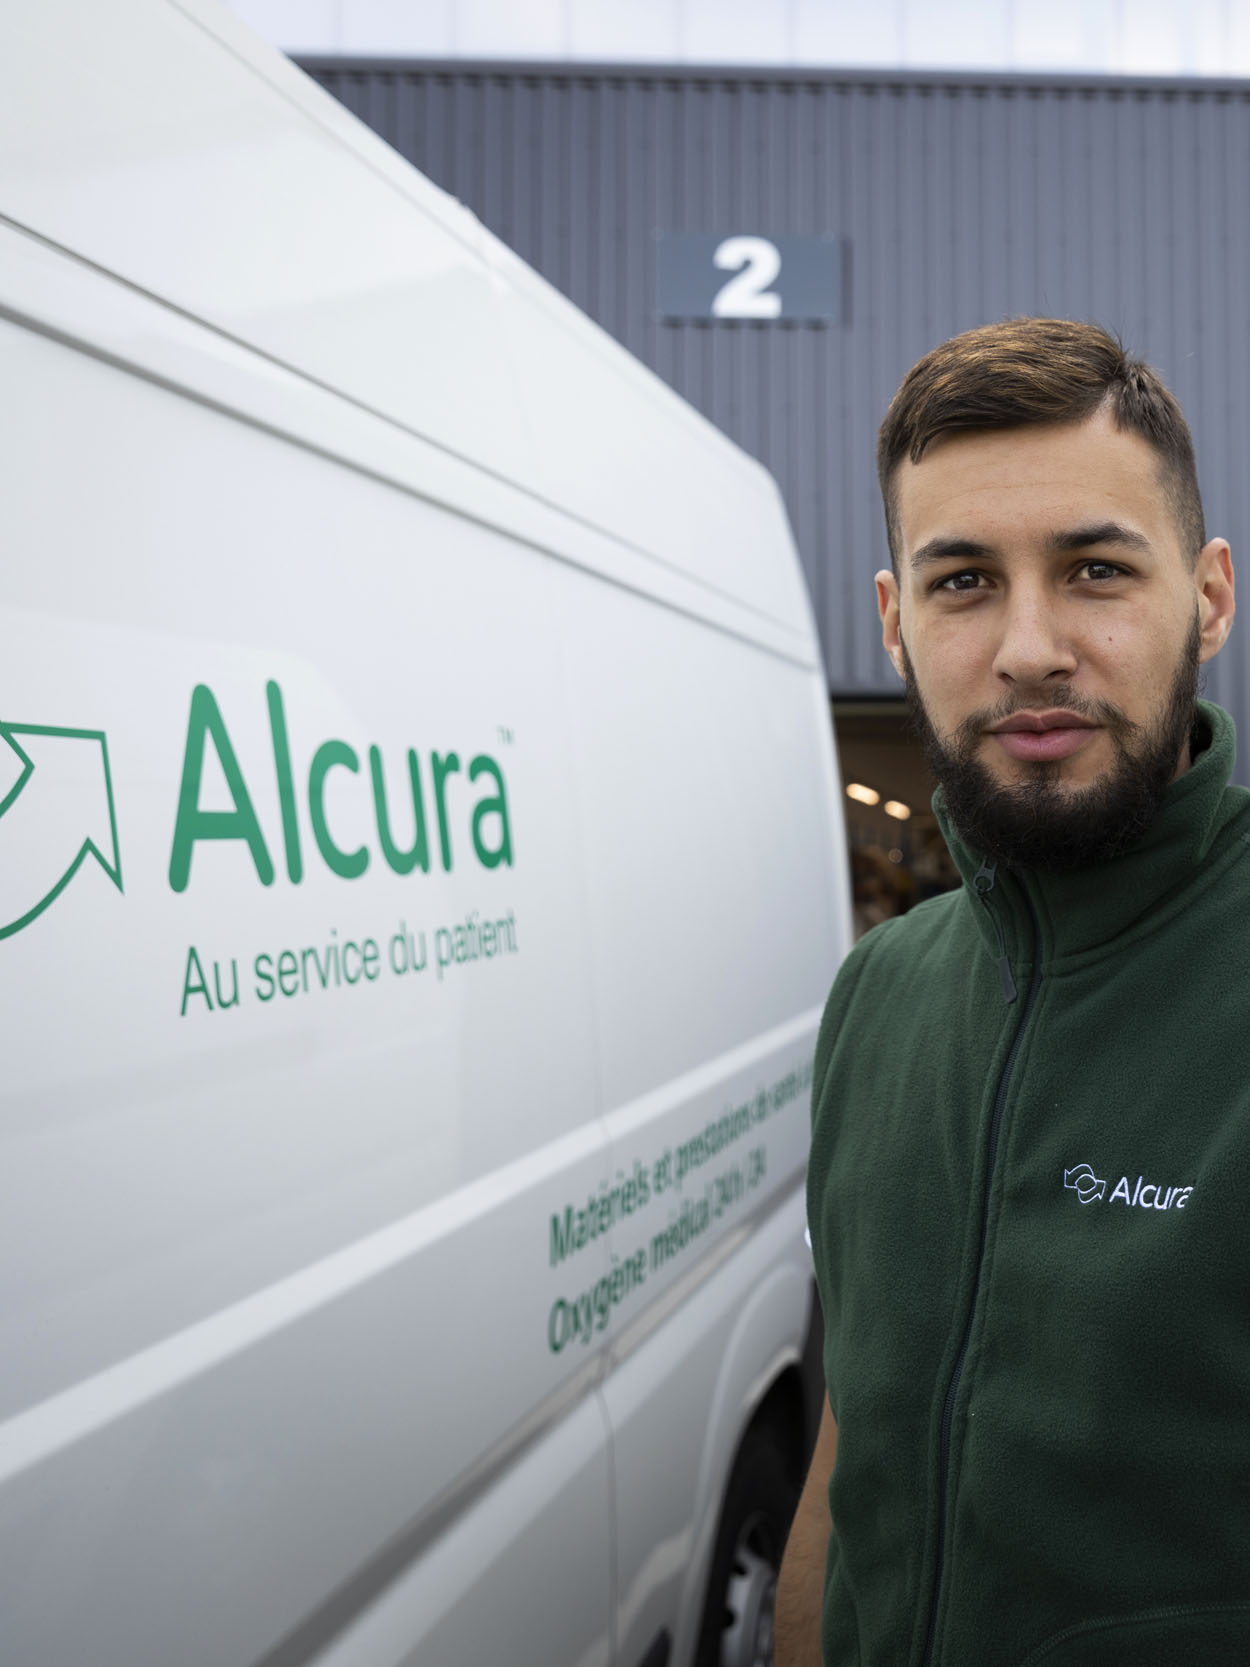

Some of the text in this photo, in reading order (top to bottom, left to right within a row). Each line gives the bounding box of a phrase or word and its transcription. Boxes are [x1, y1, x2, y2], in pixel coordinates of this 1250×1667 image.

[711, 235, 782, 319] 2
[168, 679, 515, 894] Alcura
[179, 908, 519, 1017] Au service du patient
[548, 1249, 647, 1355] Oxygène
